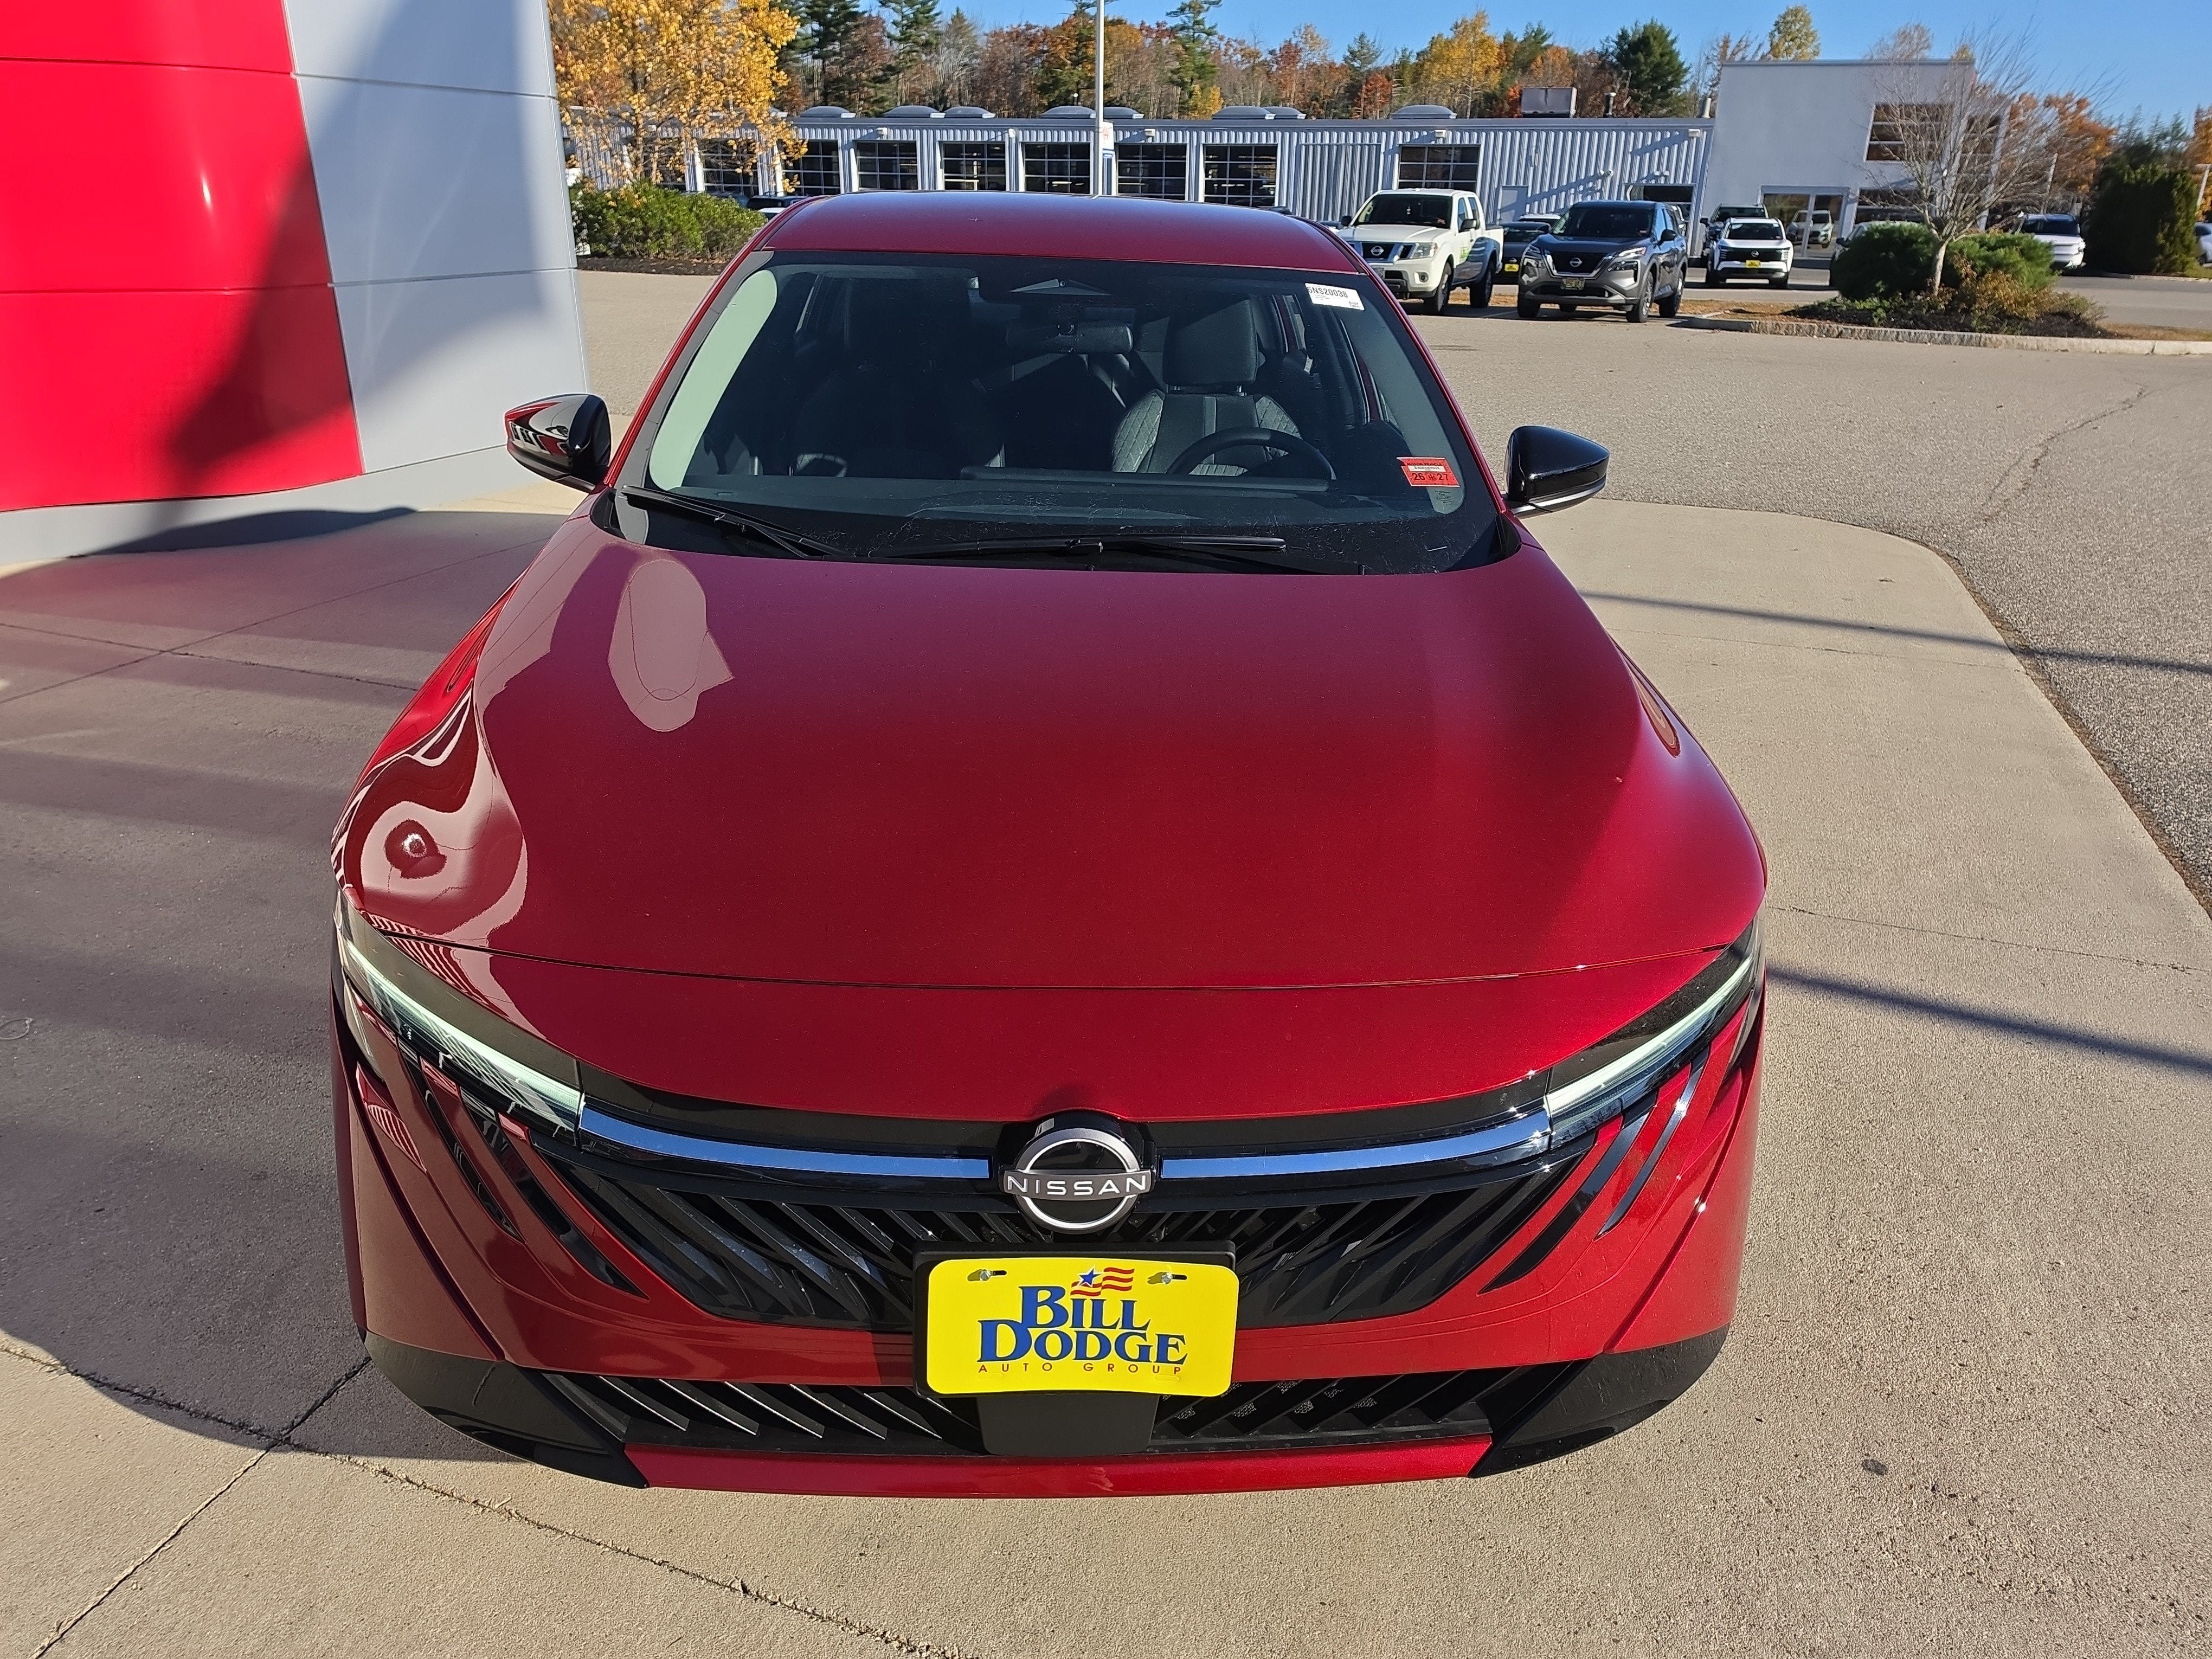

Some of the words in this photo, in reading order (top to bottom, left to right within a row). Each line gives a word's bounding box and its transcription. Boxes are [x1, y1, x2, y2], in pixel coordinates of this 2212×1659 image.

[1412, 472, 1425, 481] 26
[1436, 473, 1449, 481] 27
[1007, 1174, 1147, 1197] NISSAN
[1018, 1285, 1152, 1331] BILL
[976, 1319, 1188, 1365] DODGE
[978, 1362, 1053, 1373] AUTO
[1083, 1362, 1181, 1375] GROUP
